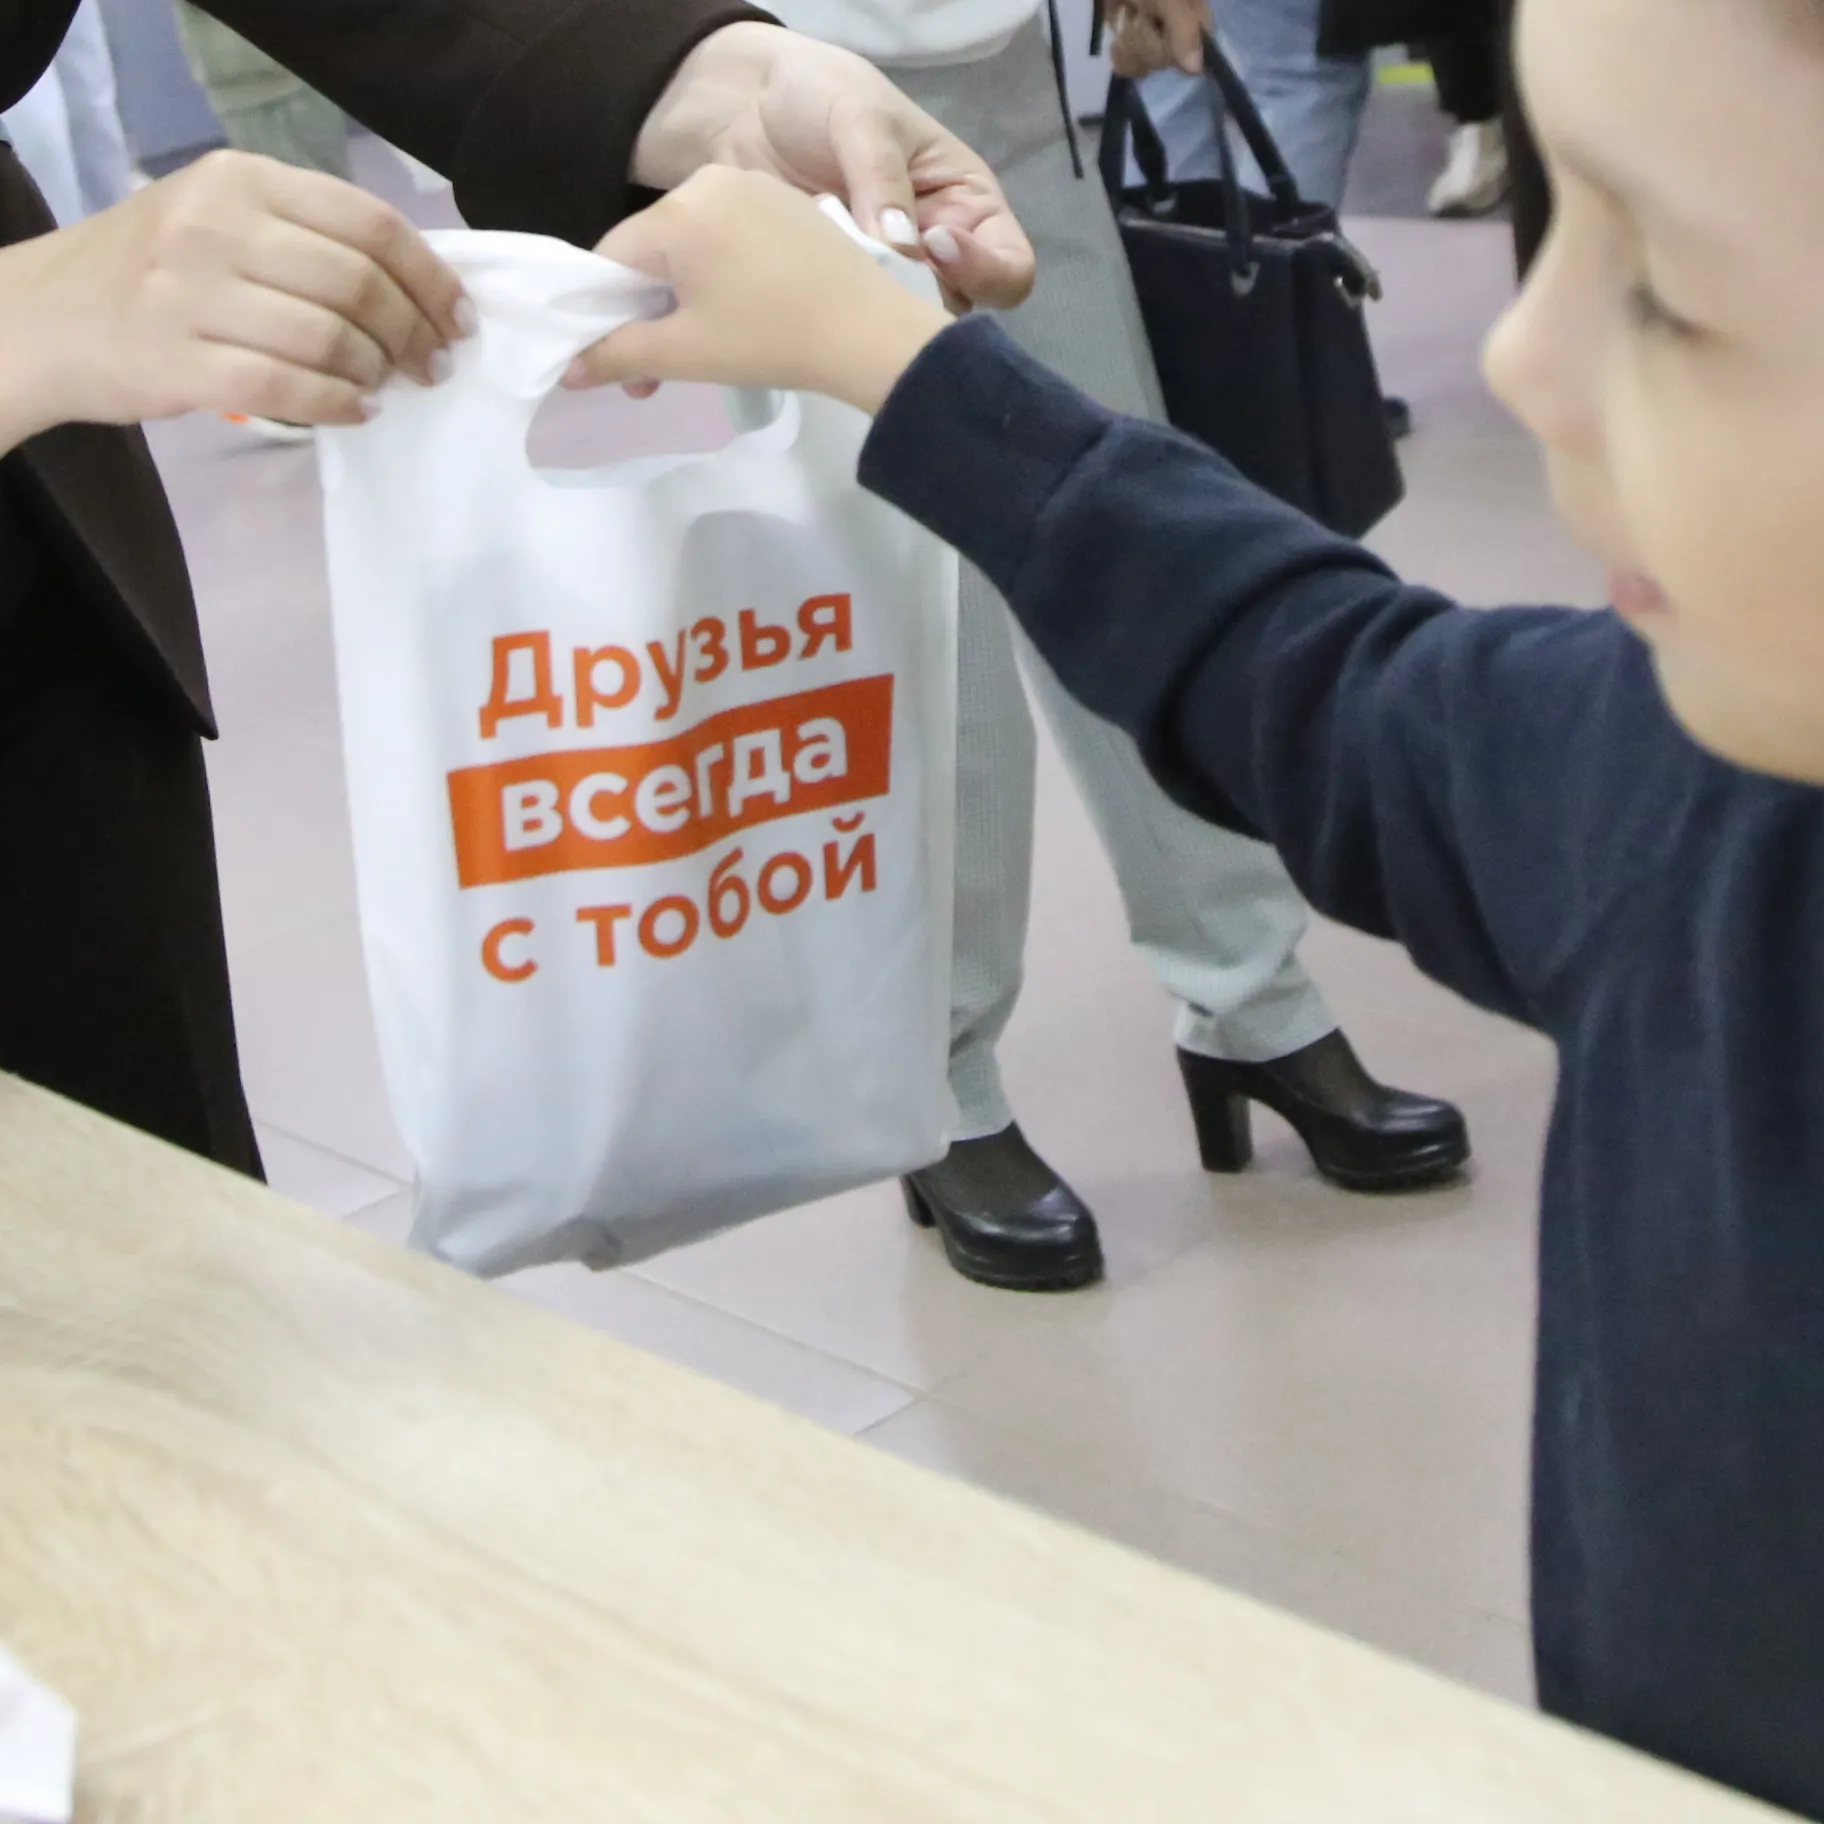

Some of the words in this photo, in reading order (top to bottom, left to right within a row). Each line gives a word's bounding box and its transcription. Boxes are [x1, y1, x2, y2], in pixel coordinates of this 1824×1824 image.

[479, 592, 852, 739] Друзья
[501, 716, 848, 852] всегда
[481, 917, 538, 983] с
[576, 811, 878, 968] тобой
